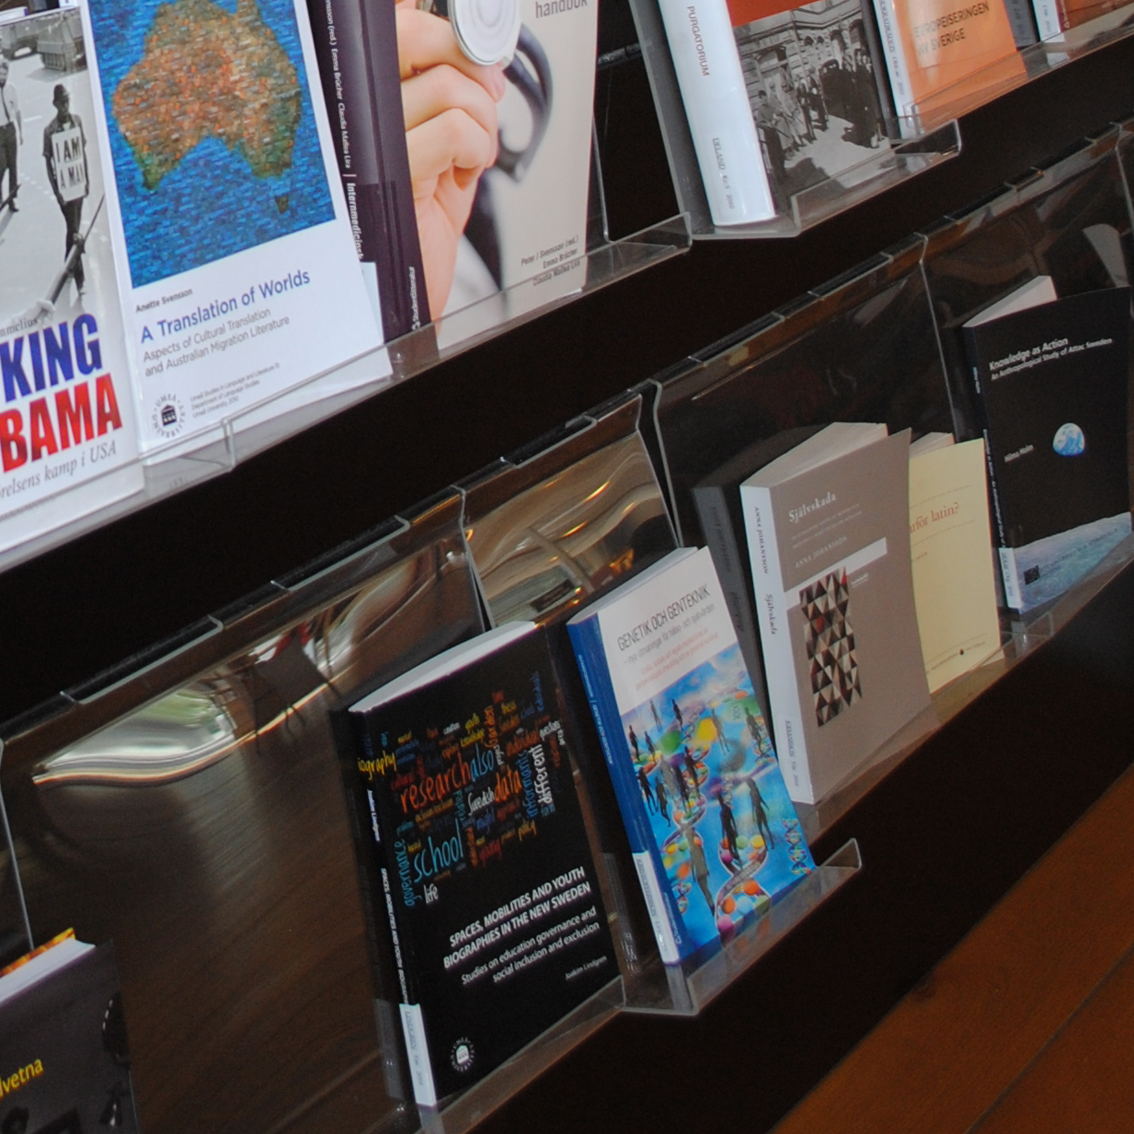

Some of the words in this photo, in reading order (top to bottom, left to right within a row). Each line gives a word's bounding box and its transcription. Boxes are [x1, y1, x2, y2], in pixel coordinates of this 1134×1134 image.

[687, 5, 710, 77] PURGATORIUM
[930, 27, 966, 51] SVERIGE
[64, 136, 82, 163] AM
[135, 299, 161, 313] Anette
[162, 288, 193, 305] Svensson
[140, 325, 154, 344] A
[157, 296, 238, 337] Translation
[241, 286, 256, 306] of
[258, 269, 311, 299] Worlds
[143, 341, 182, 363] Aspects
[183, 335, 194, 349] of
[194, 323, 227, 345] Cultural
[228, 307, 271, 332] Translation
[144, 361, 164, 377] and
[166, 345, 209, 371] Australian
[211, 329, 249, 354] Migration
[250, 316, 290, 338] Literature
[989, 350, 1031, 371] Knowledge
[1032, 347, 1041, 355] as
[1042, 338, 1068, 352] Action
[44, 459, 79, 491] kamp
[80, 454, 87, 471] i
[88, 440, 117, 467] USA
[788, 491, 836, 524] Självskada
[931, 502, 959, 522] latin?
[617, 620, 653, 651] GENETIK
[651, 609, 668, 630] OCH
[666, 584, 710, 619] GENTEKNIK
[400, 751, 471, 814] research
[470, 743, 496, 782] also
[494, 764, 522, 803] data
[527, 744, 554, 805] different
[467, 787, 496, 816] Swedish
[394, 839, 422, 907] governance
[414, 817, 464, 883] school
[423, 883, 439, 905] life
[449, 920, 484, 948] SPACES,
[484, 892, 532, 927] MOBILITIES
[532, 882, 552, 901] AND
[552, 866, 585, 889] YOUTH
[443, 929, 501, 969] BIOGRAPHIES
[501, 921, 512, 935] IN
[511, 913, 529, 930] THE
[529, 902, 551, 921] NEW
[551, 881, 591, 909] SWEDEN
[461, 965, 488, 985] Studies
[488, 959, 499, 970] on
[499, 938, 536, 963] education
[536, 917, 580, 945] governance
[580, 906, 597, 921] and
[492, 964, 514, 983] social
[515, 948, 548, 971] inclusion
[548, 938, 564, 953] and
[564, 922, 600, 945] exclusion
